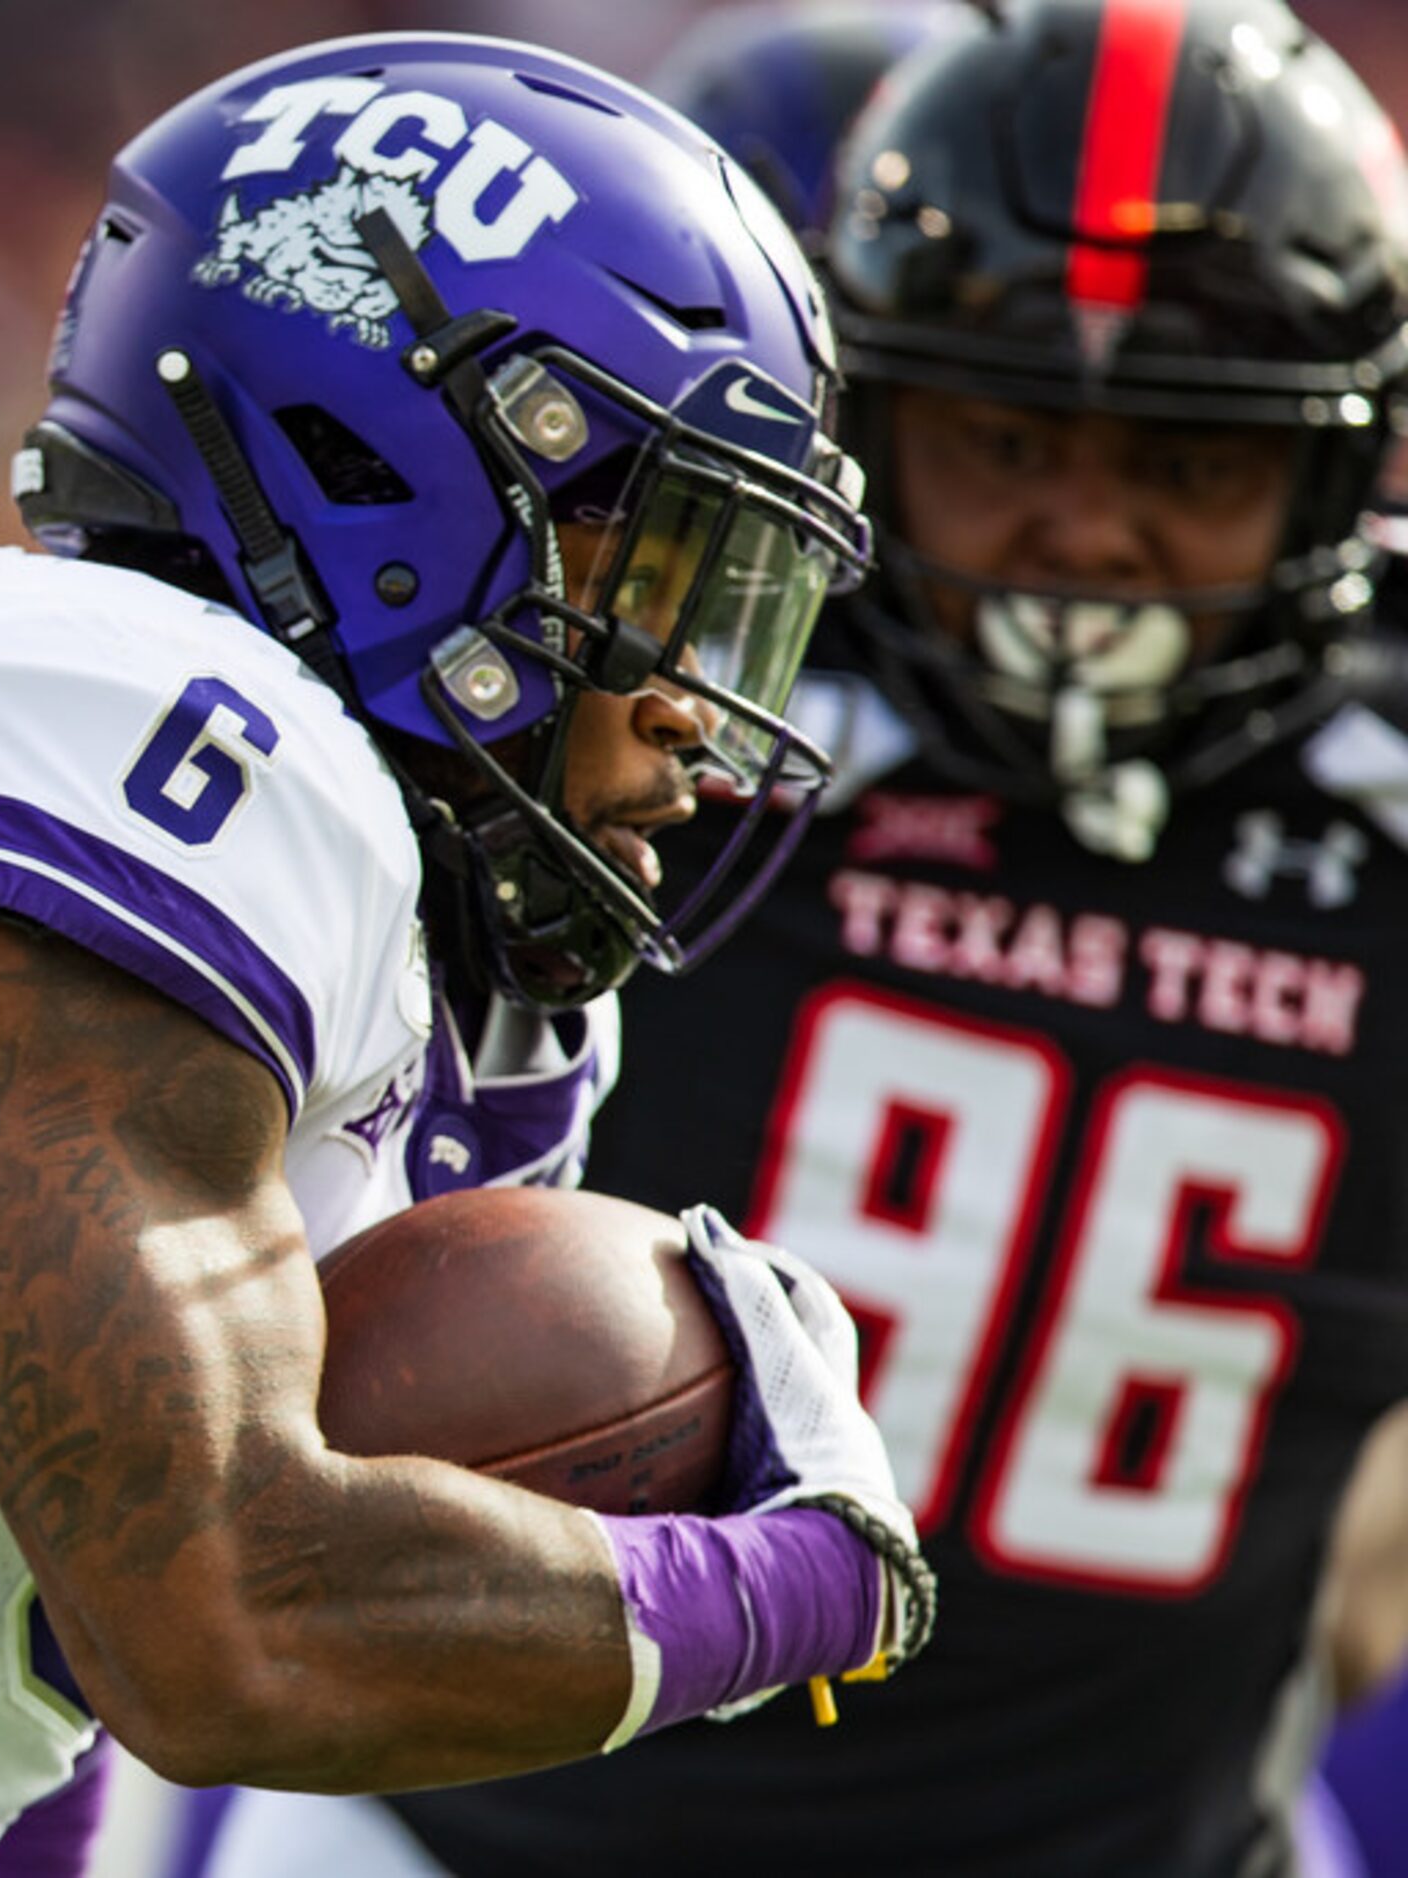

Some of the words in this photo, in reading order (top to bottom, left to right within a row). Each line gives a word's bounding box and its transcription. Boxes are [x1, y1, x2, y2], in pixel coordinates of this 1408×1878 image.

[219, 77, 580, 264] TCU
[119, 674, 283, 852] 6
[830, 868, 1128, 1009] TEXAS
[1140, 927, 1363, 1057] TECH
[744, 980, 1348, 1600] 96
